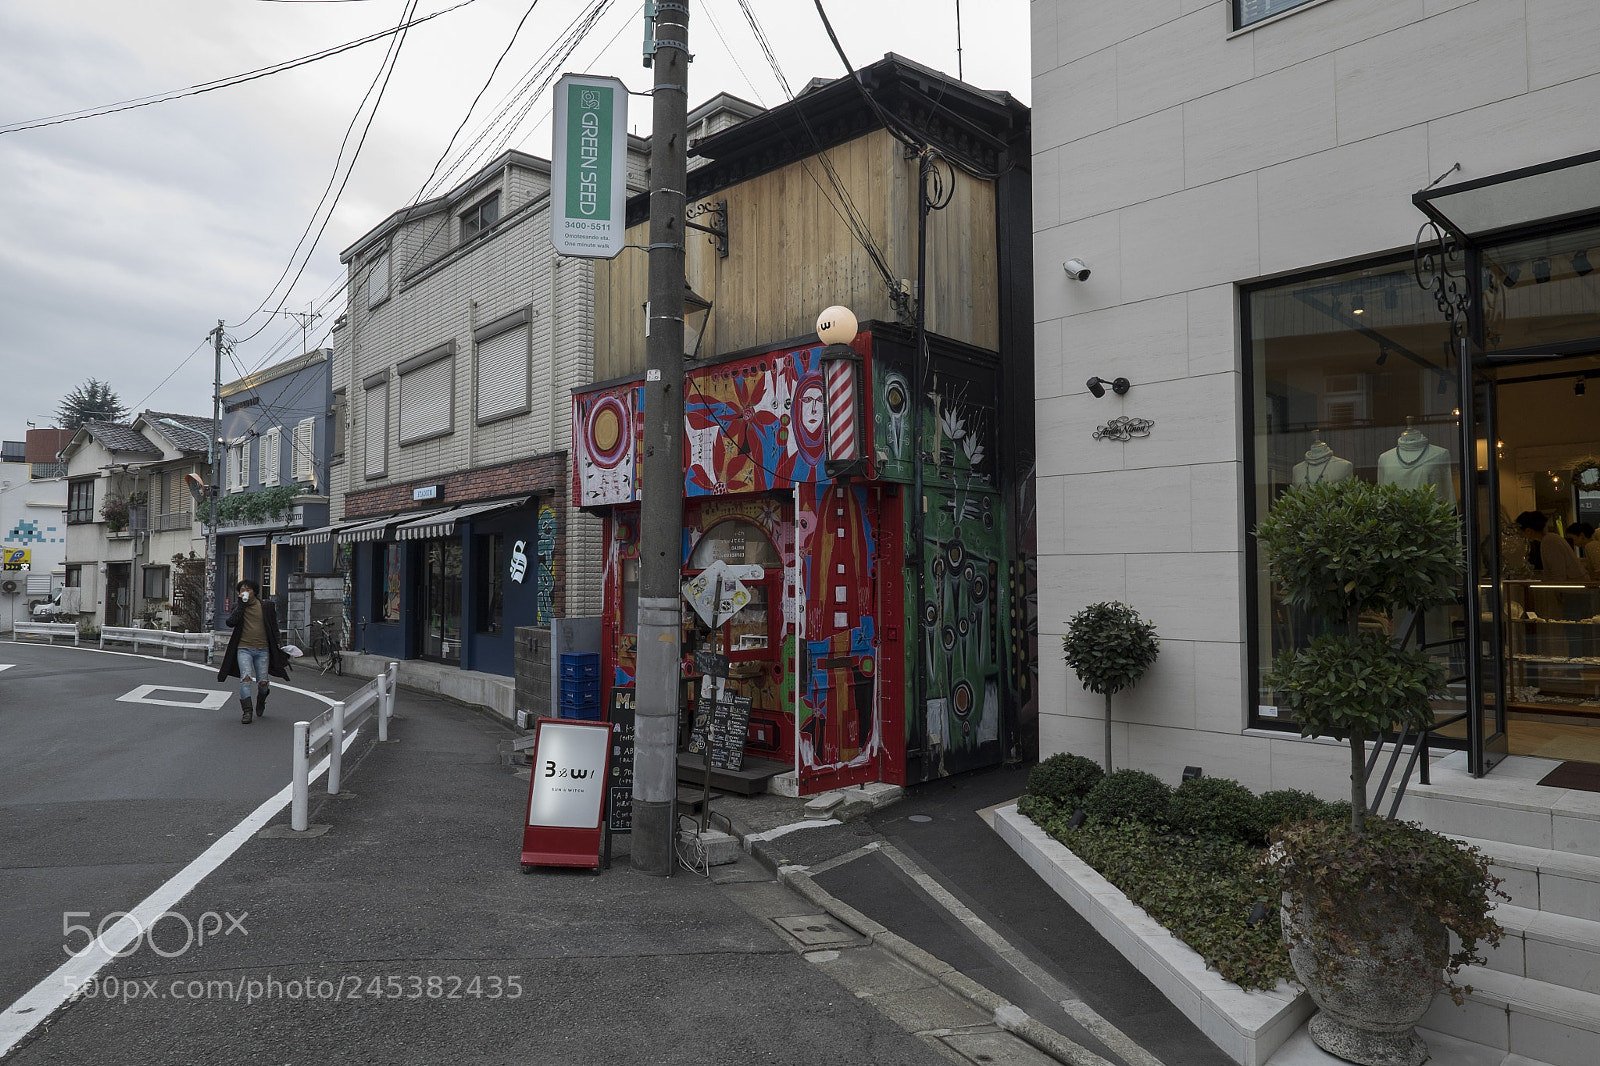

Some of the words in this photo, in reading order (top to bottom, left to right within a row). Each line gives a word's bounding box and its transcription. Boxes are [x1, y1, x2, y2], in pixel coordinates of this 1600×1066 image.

[580, 112, 598, 170] GREEN
[580, 172, 597, 215] SEED
[565, 221, 610, 231] 3400-5511
